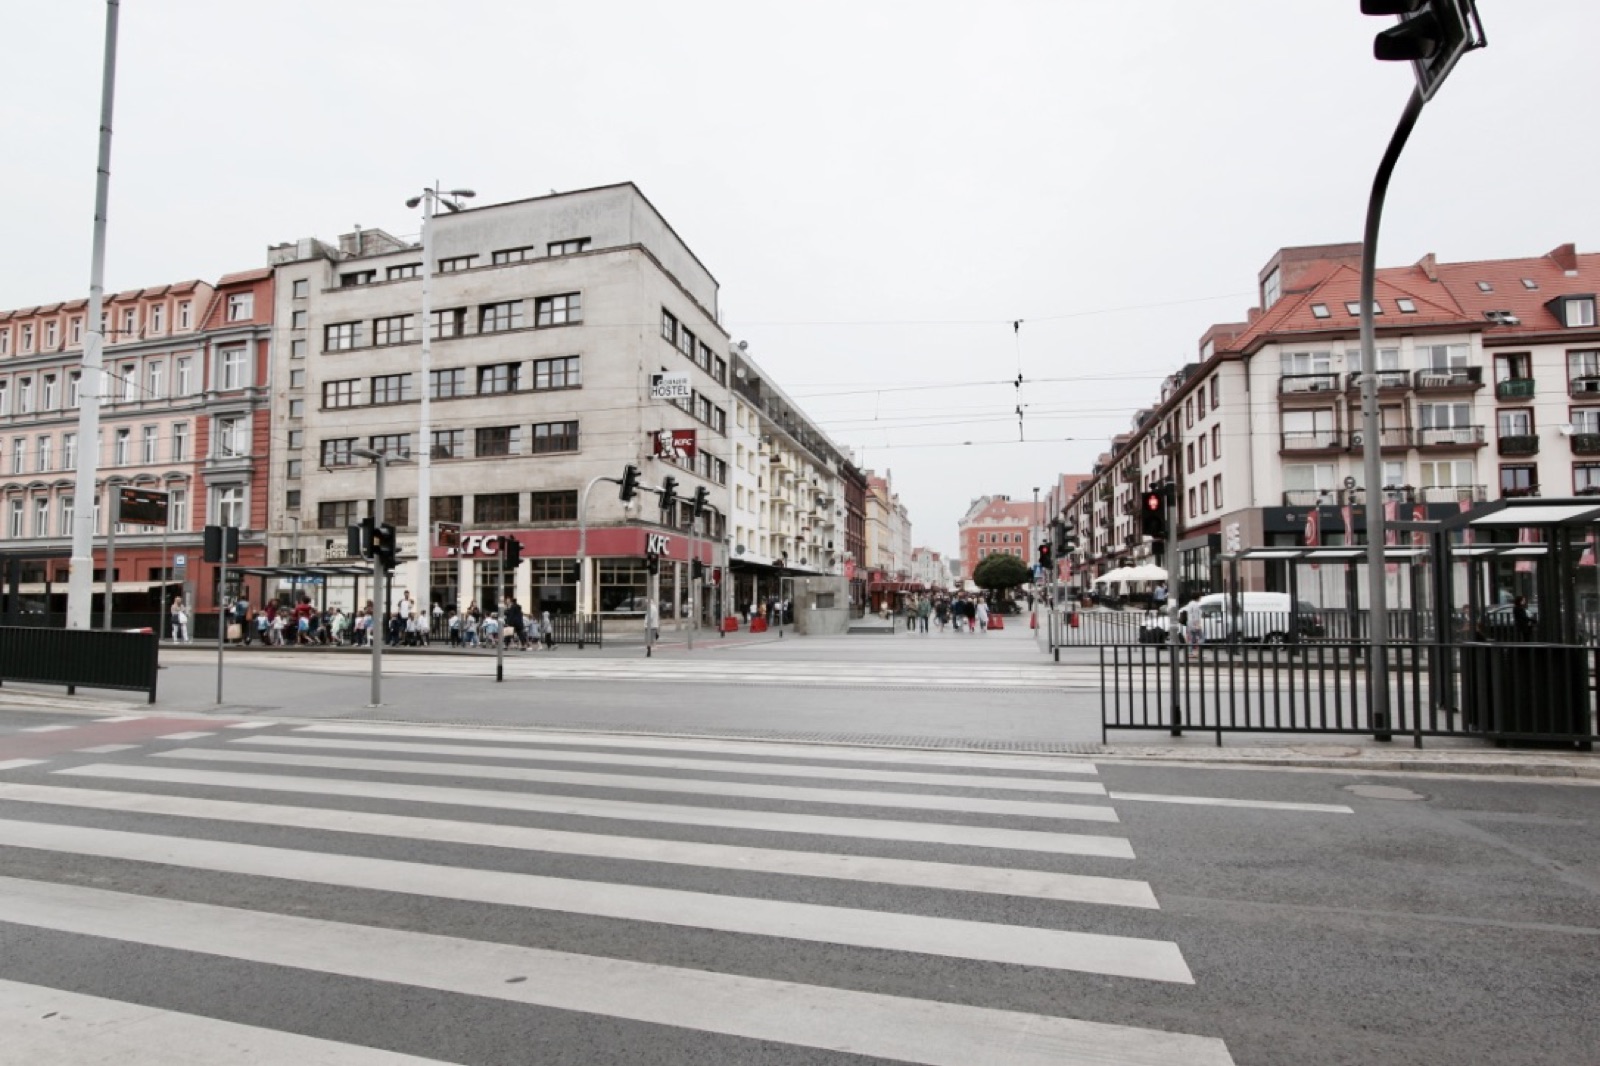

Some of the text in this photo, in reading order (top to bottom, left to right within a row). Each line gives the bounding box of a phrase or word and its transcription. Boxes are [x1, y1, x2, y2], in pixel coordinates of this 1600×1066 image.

[652, 385, 689, 397] HOSTEL
[674, 438, 693, 446] KFC
[647, 533, 670, 555] KFC
